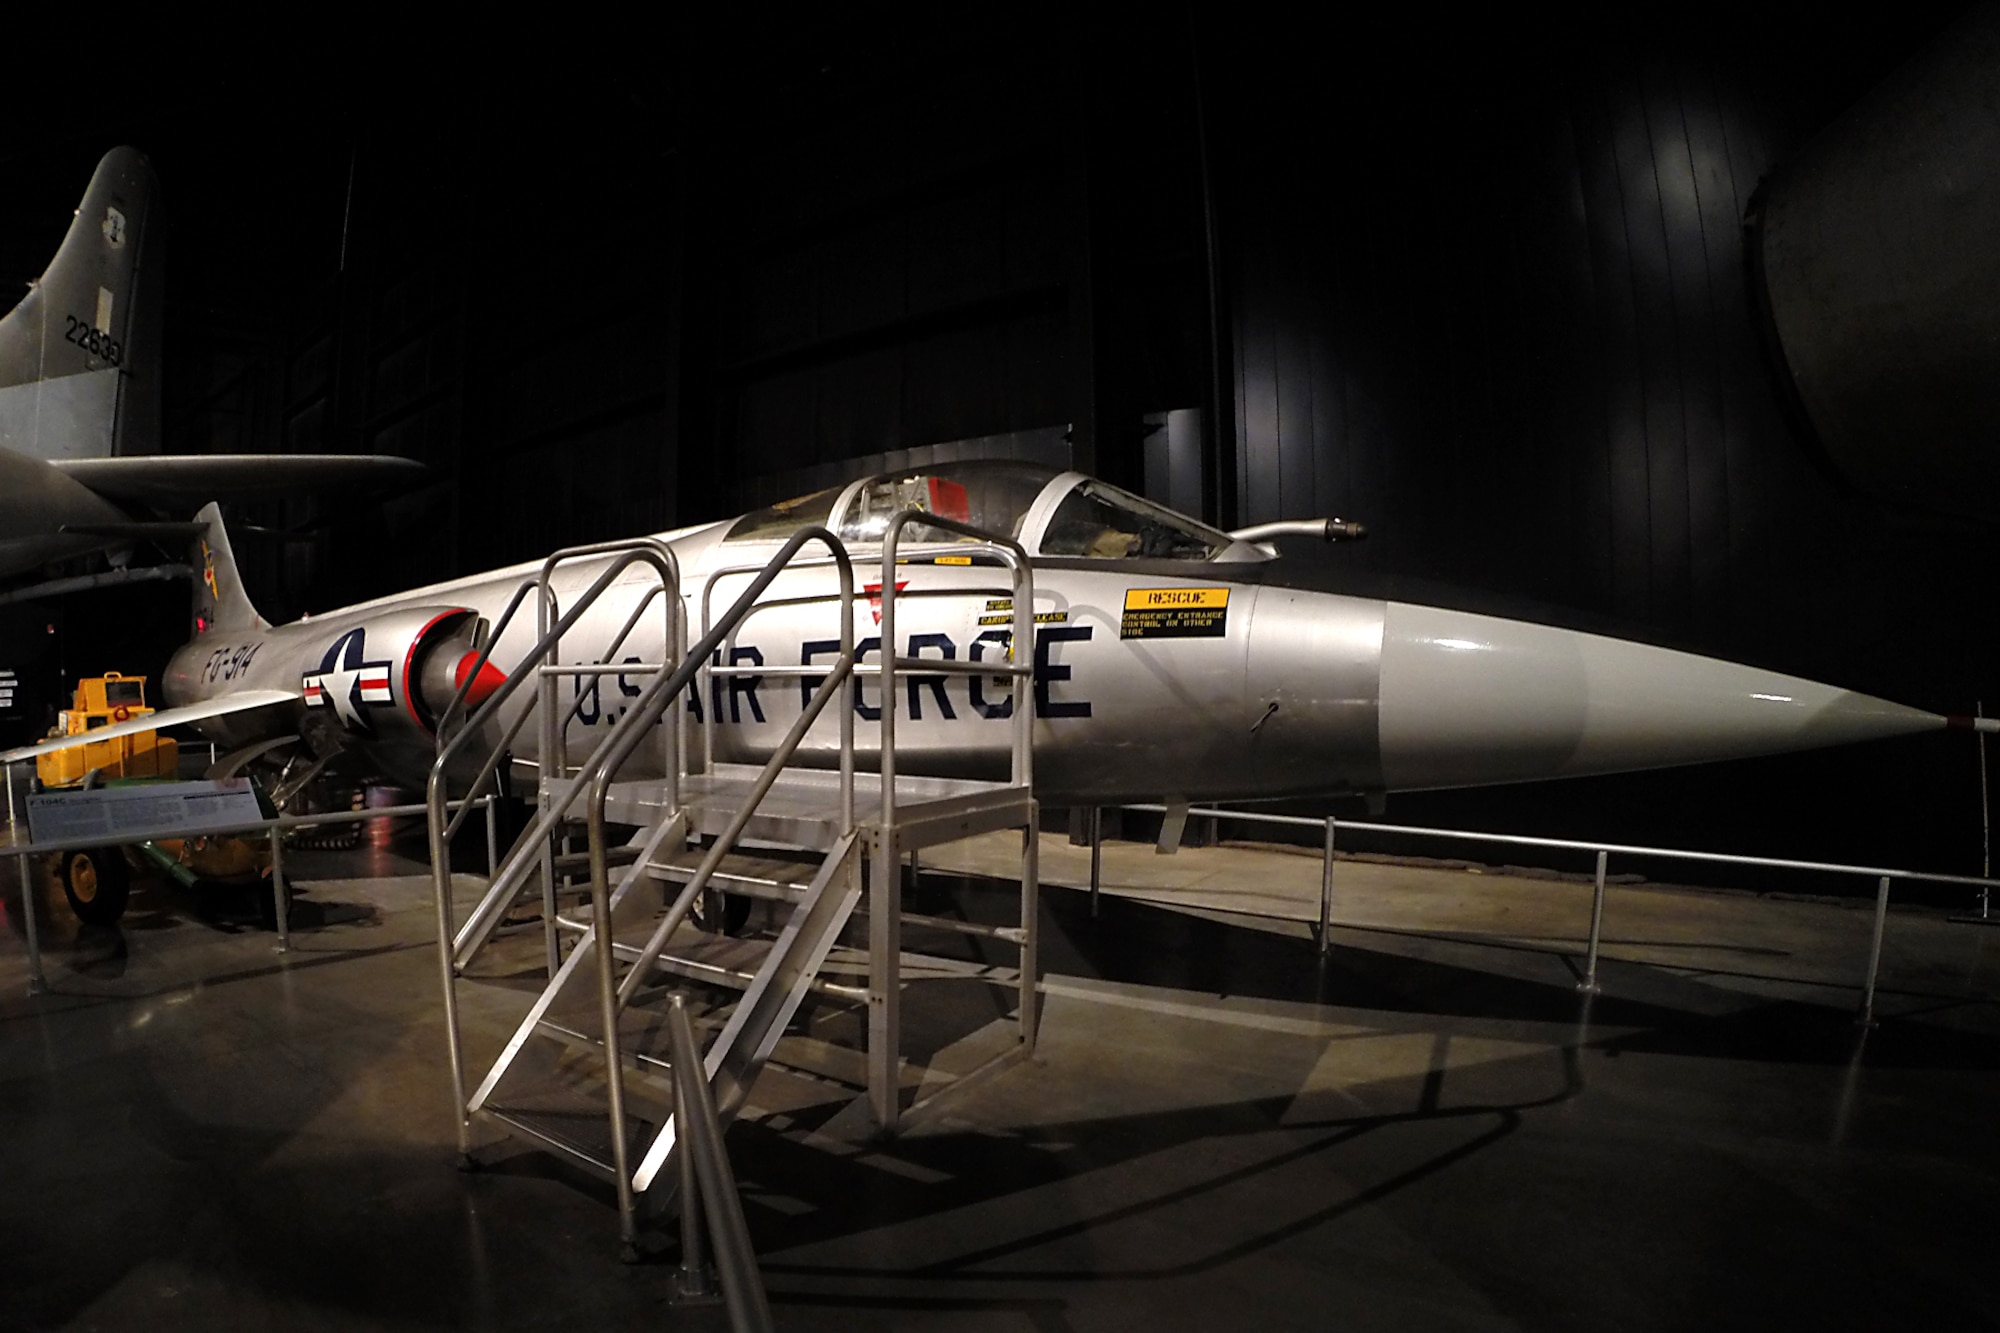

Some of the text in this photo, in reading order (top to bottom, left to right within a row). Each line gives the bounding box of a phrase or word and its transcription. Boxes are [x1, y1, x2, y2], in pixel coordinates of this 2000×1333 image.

[1147, 592, 1206, 604] RESCUE
[1122, 611, 1224, 621] EMERGENCY ENTRANCE
[1121, 620, 1161, 628] CONTROL
[1183, 619, 1212, 627] OTHER
[1121, 628, 1143, 636] SIDE
[200, 641, 264, 684] FG-914
[801, 626, 1093, 720] FORCE
